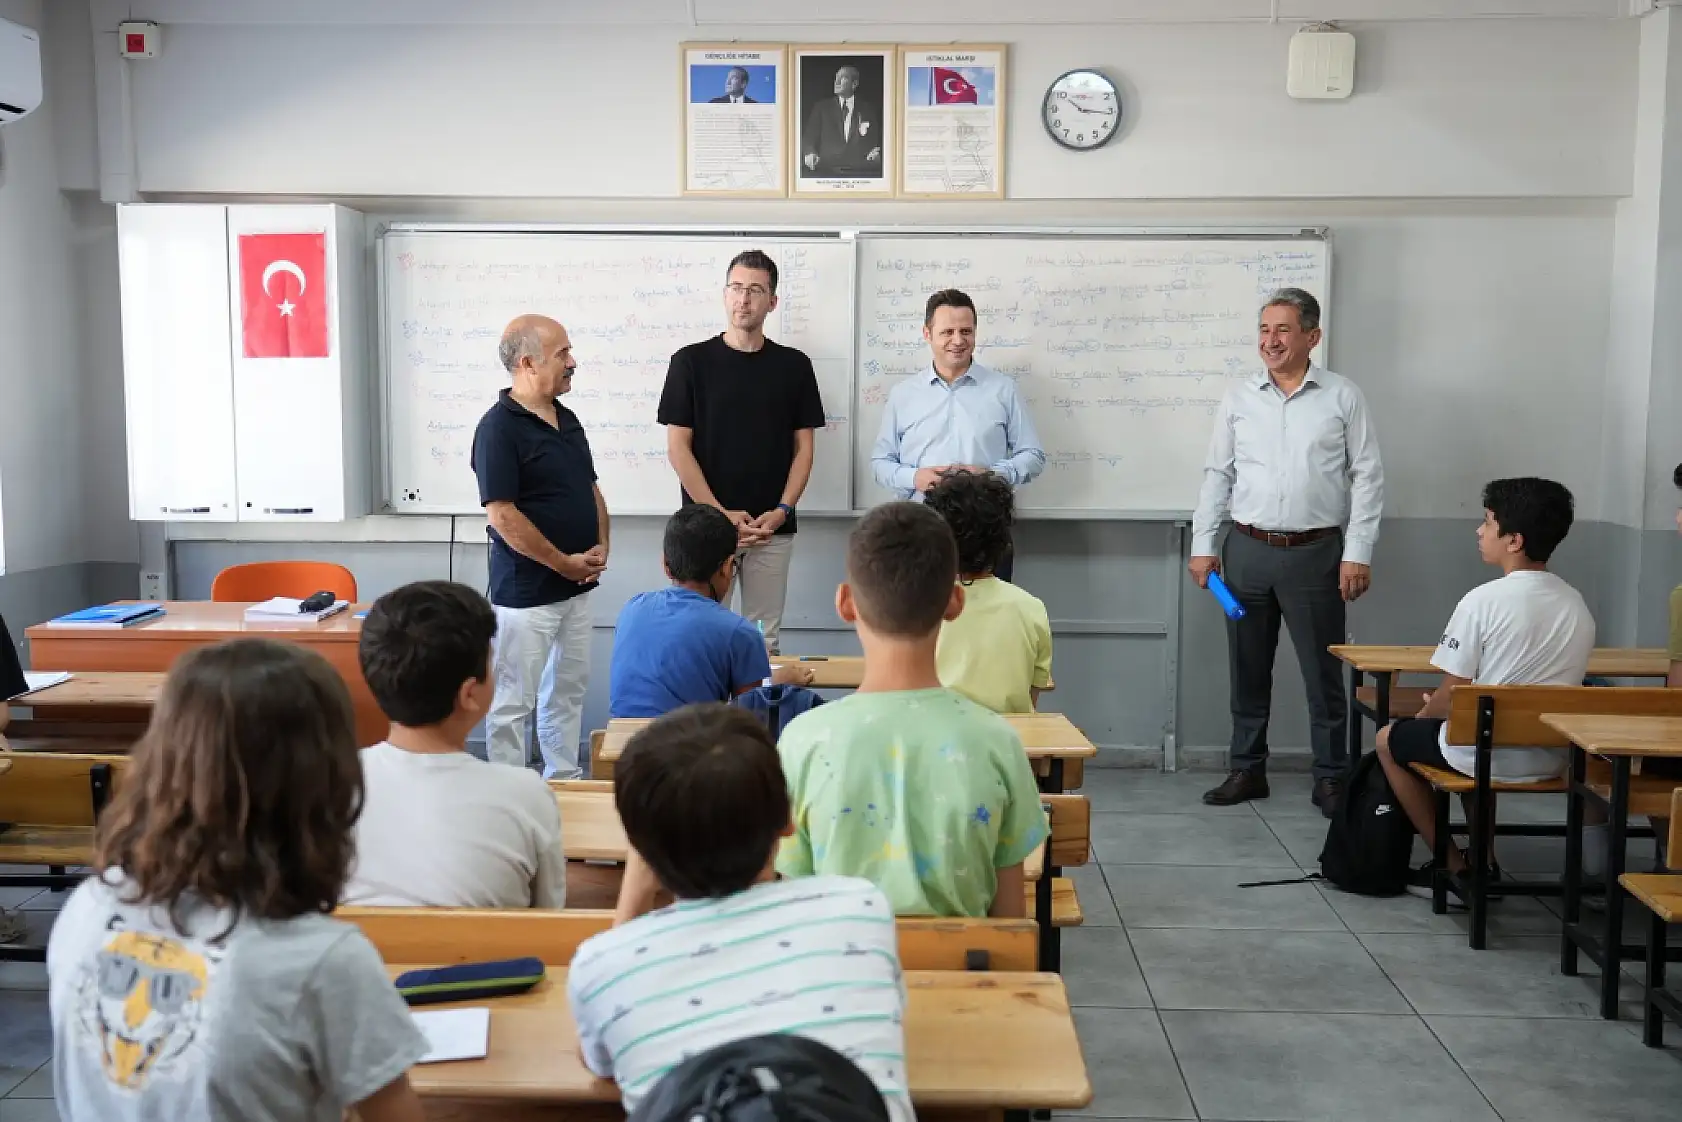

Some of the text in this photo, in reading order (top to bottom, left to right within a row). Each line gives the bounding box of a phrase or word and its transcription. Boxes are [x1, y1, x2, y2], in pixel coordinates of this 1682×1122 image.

[1057, 91, 1067, 99] 10
[1103, 92, 1110, 100] 2
[1053, 119, 1061, 128] 8
[1063, 129, 1070, 138] 7
[1092, 130, 1099, 139] 5
